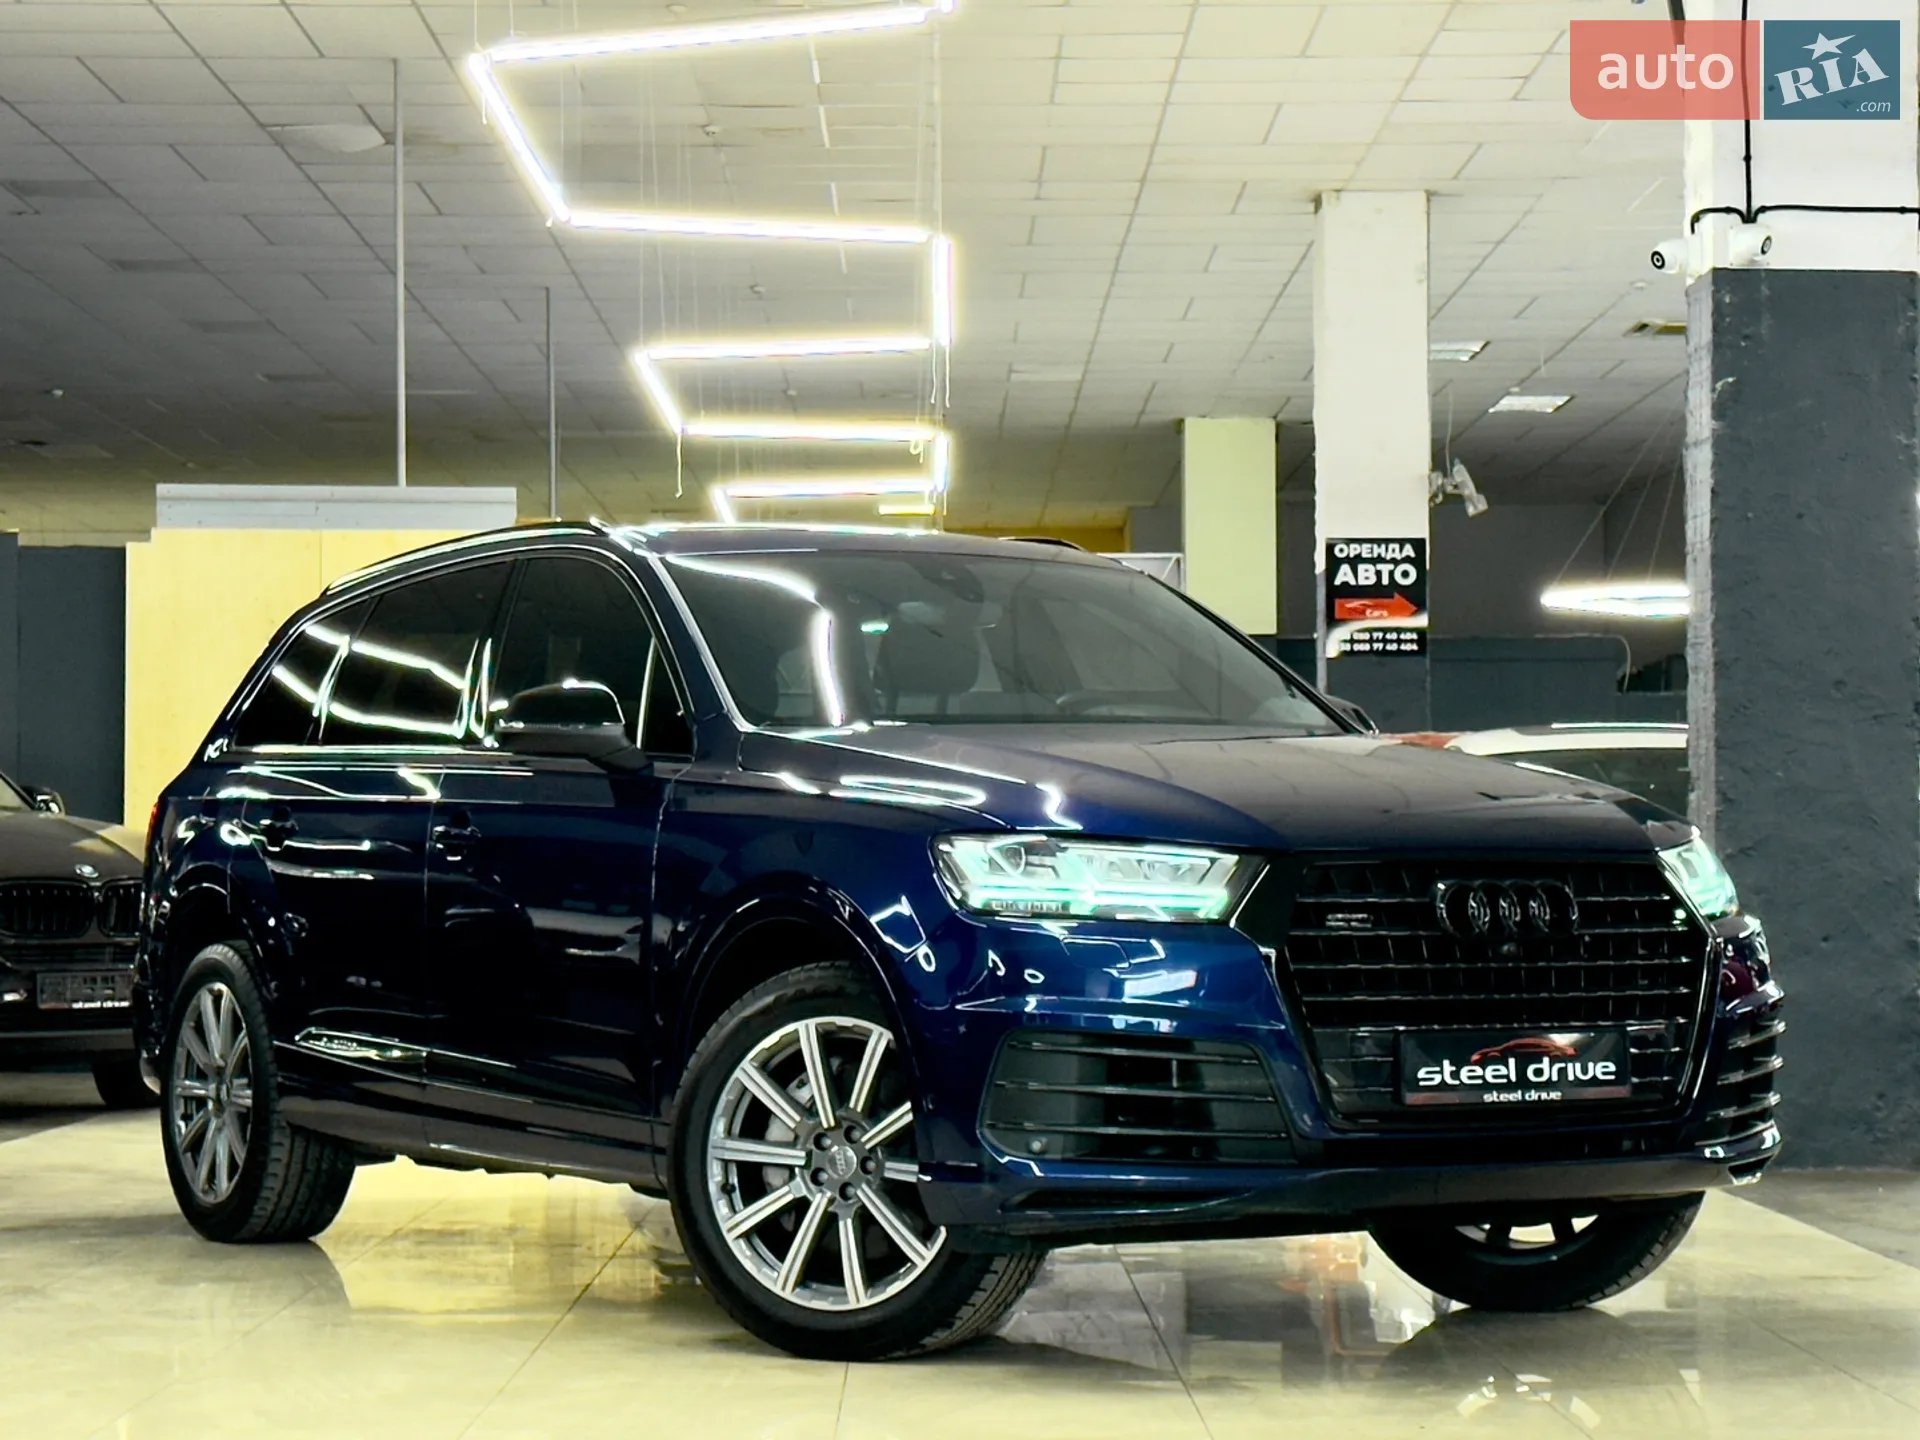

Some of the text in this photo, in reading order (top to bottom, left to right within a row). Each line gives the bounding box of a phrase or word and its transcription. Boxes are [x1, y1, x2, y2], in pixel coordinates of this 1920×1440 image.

[1334, 543, 1416, 560] ОРЕНДА
[1333, 563, 1417, 586] АВТО
[1417, 1056, 1616, 1086] steel drive
[1483, 1089, 1562, 1103] steel drive
